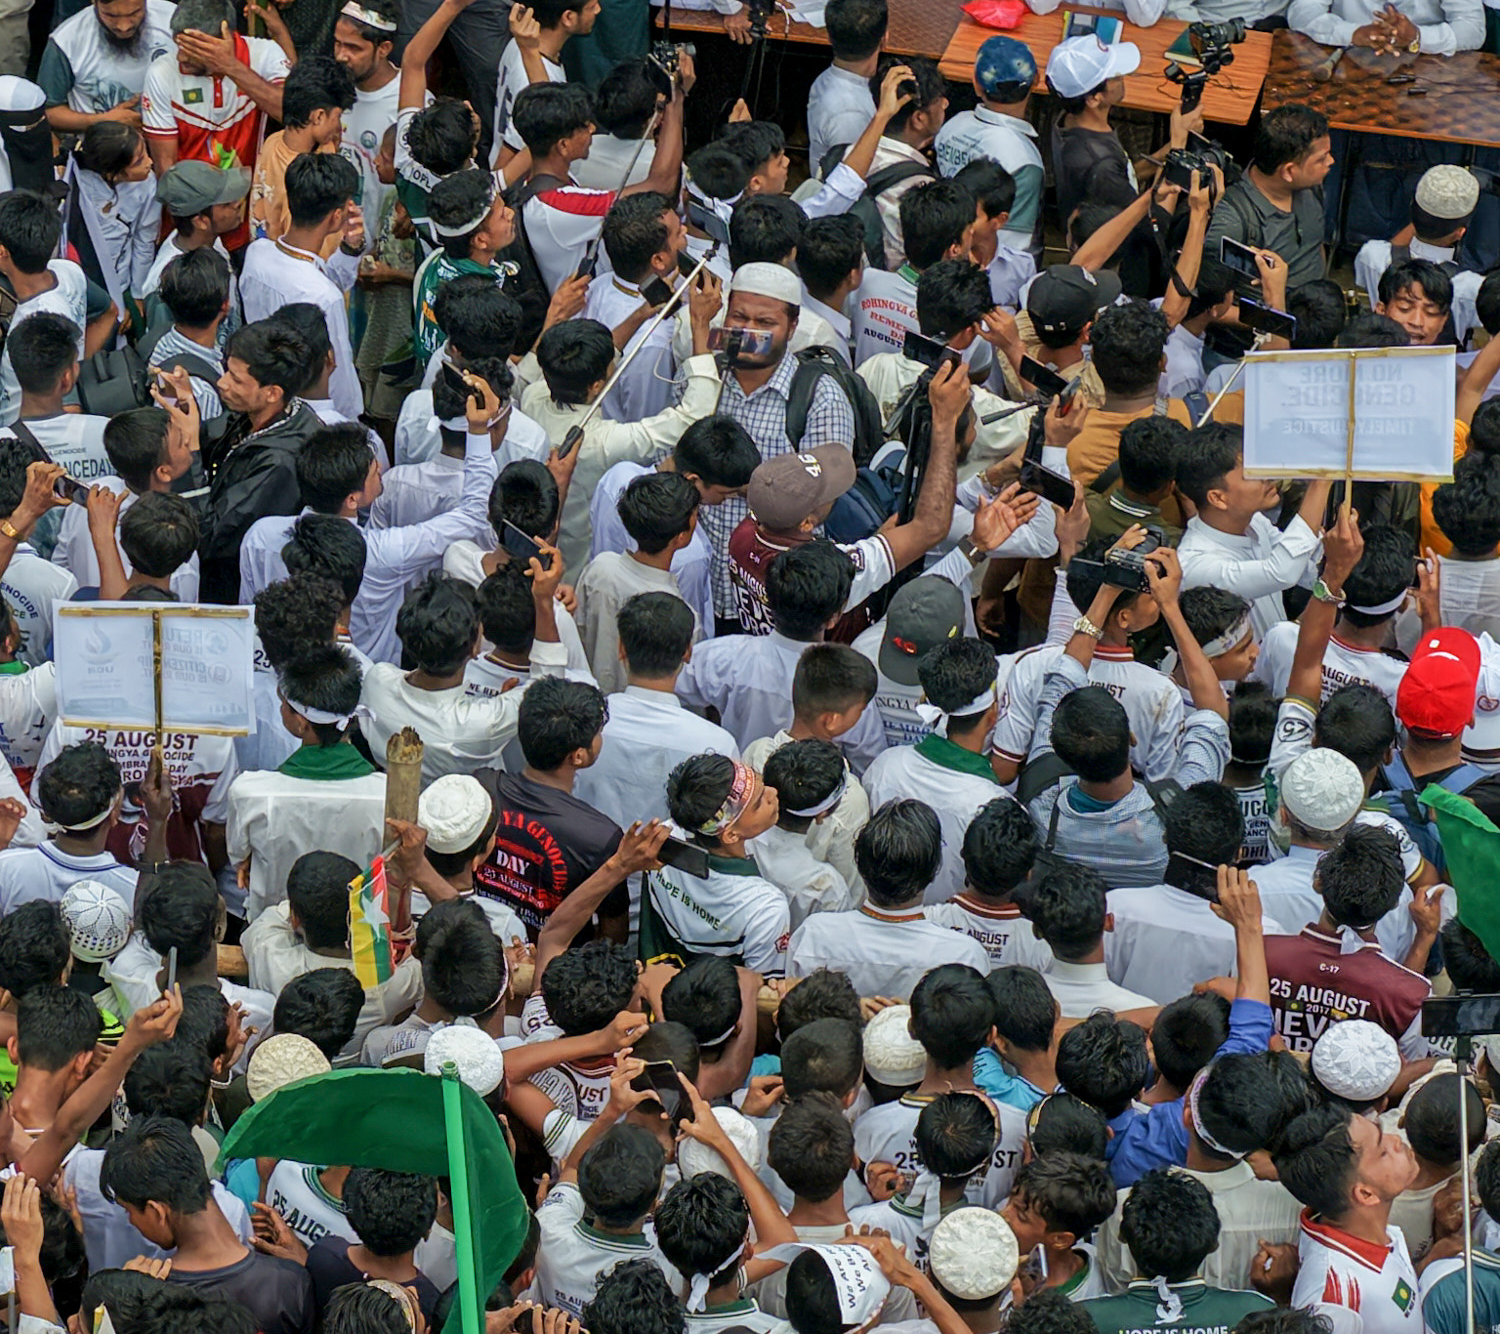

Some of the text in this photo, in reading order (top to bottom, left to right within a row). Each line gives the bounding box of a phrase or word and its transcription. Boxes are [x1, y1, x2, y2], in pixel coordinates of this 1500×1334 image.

[1269, 977, 1371, 1017] 25 AUGUST
[1305, 1002, 1330, 1015] 2017
